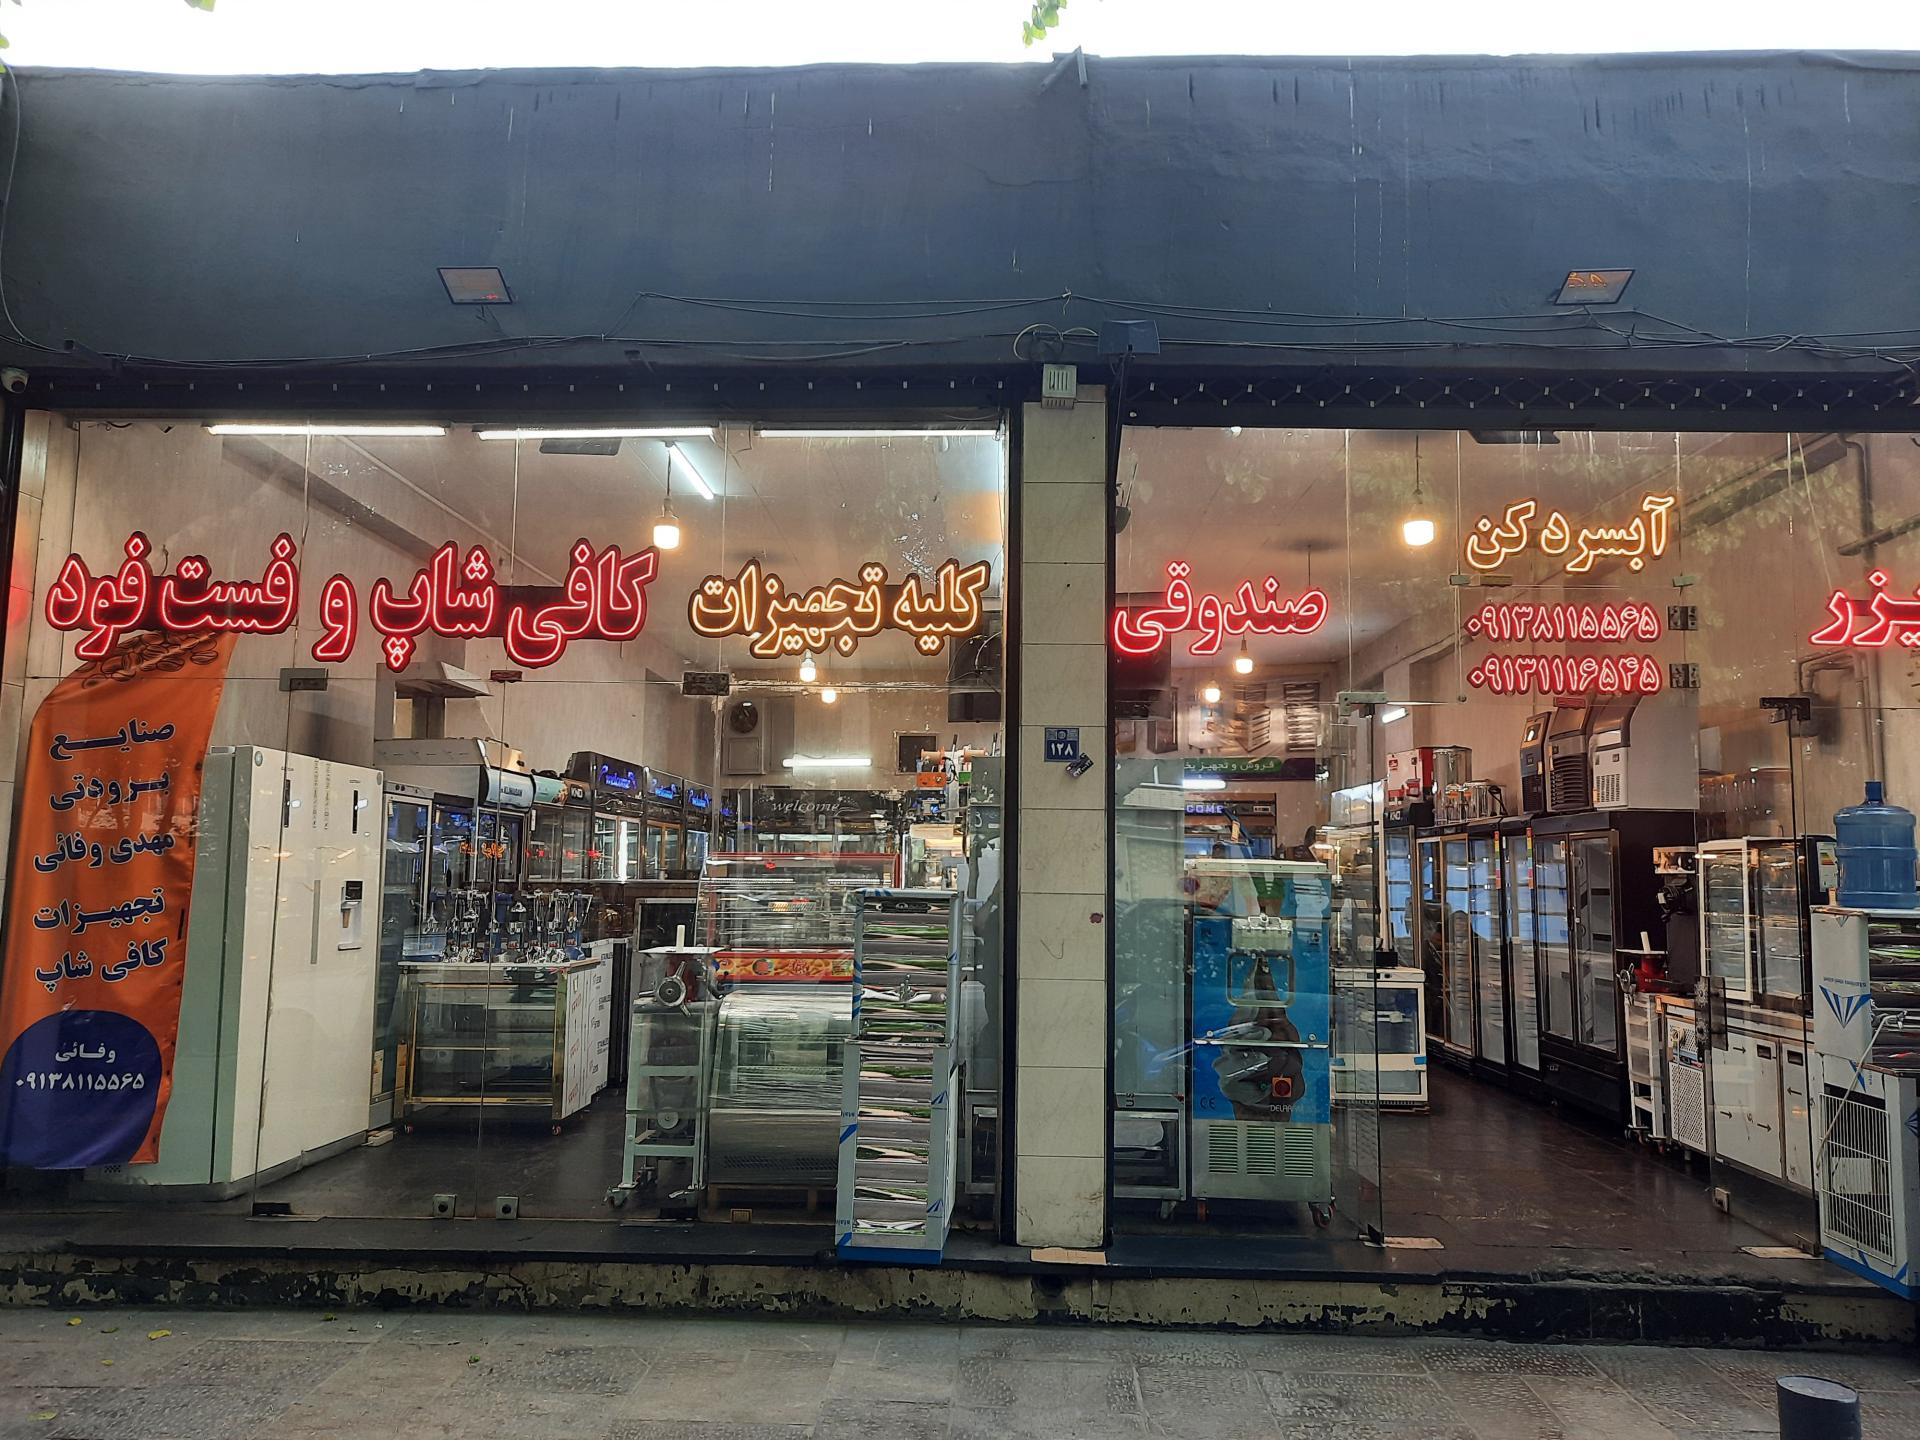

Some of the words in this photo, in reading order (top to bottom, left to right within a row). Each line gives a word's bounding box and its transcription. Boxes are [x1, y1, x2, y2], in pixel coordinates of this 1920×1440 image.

[1466, 500, 1537, 571] کن
[1539, 494, 1676, 573] آبسرد
[46, 532, 151, 660] فود
[161, 532, 298, 630] فست
[371, 540, 493, 669] شاپ
[506, 540, 658, 667] کافی
[313, 574, 356, 661] و
[690, 560, 886, 656] تجهیزات
[893, 562, 989, 652] کلیه
[1114, 560, 1329, 656] صندوقی
[1467, 605, 1660, 641] ۰۹۱۳۸۱۱۵۵۶۵
[1470, 656, 1661, 692] ۰۹۱۳۱۱۱۶۵۴۵
[48, 718, 176, 761] صنایع
[1050, 742, 1074, 757] ۱۲۸
[49, 771, 171, 812] برودتی
[771, 798, 841, 815] welcome
[109, 830, 176, 865] مهدی
[32, 886, 165, 935] تجهیزات
[35, 951, 93, 994] شاپ
[101, 937, 169, 983] کافی
[15, 1071, 146, 1091] ۰۹۱۳۸۱۱۵۵۶۵
